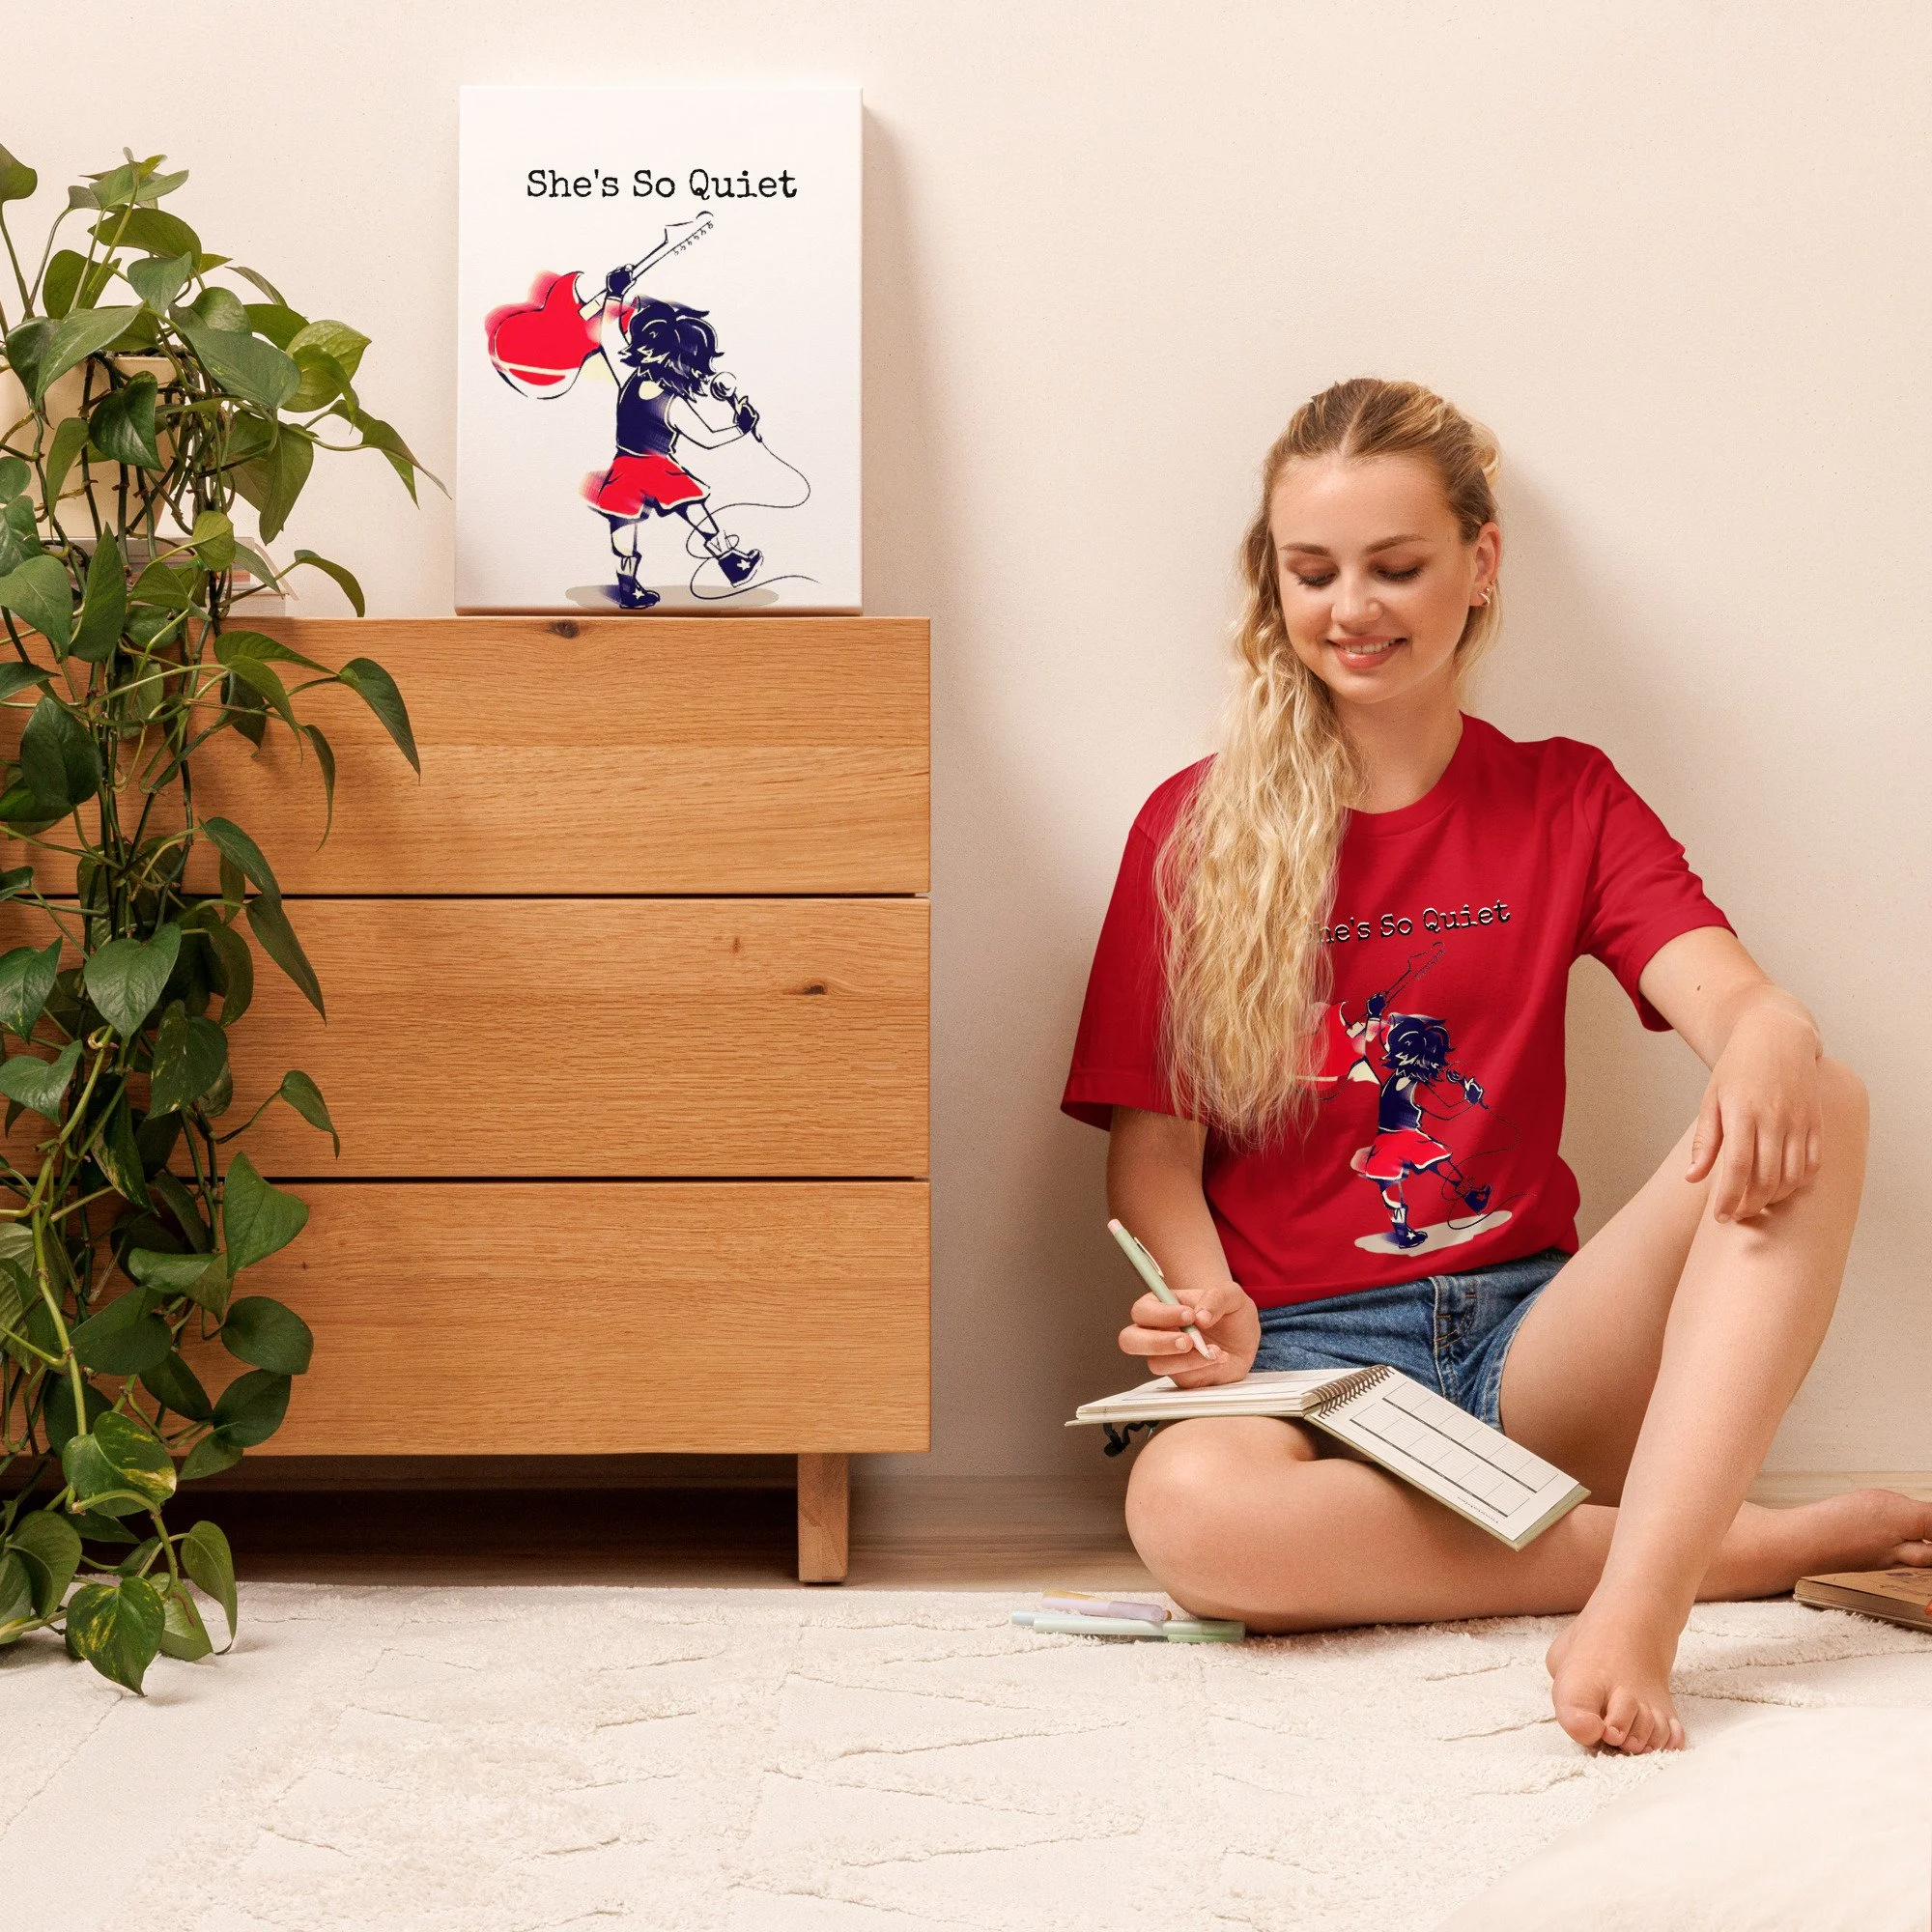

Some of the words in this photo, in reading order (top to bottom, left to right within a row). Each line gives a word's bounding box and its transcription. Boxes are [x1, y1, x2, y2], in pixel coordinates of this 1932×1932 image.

[526, 168, 619, 198] She's
[633, 169, 676, 198] So
[689, 168, 798, 201] Quiet
[1313, 916, 1371, 945] he's
[1379, 913, 1413, 938] So
[1422, 899, 1511, 933] Quiet
